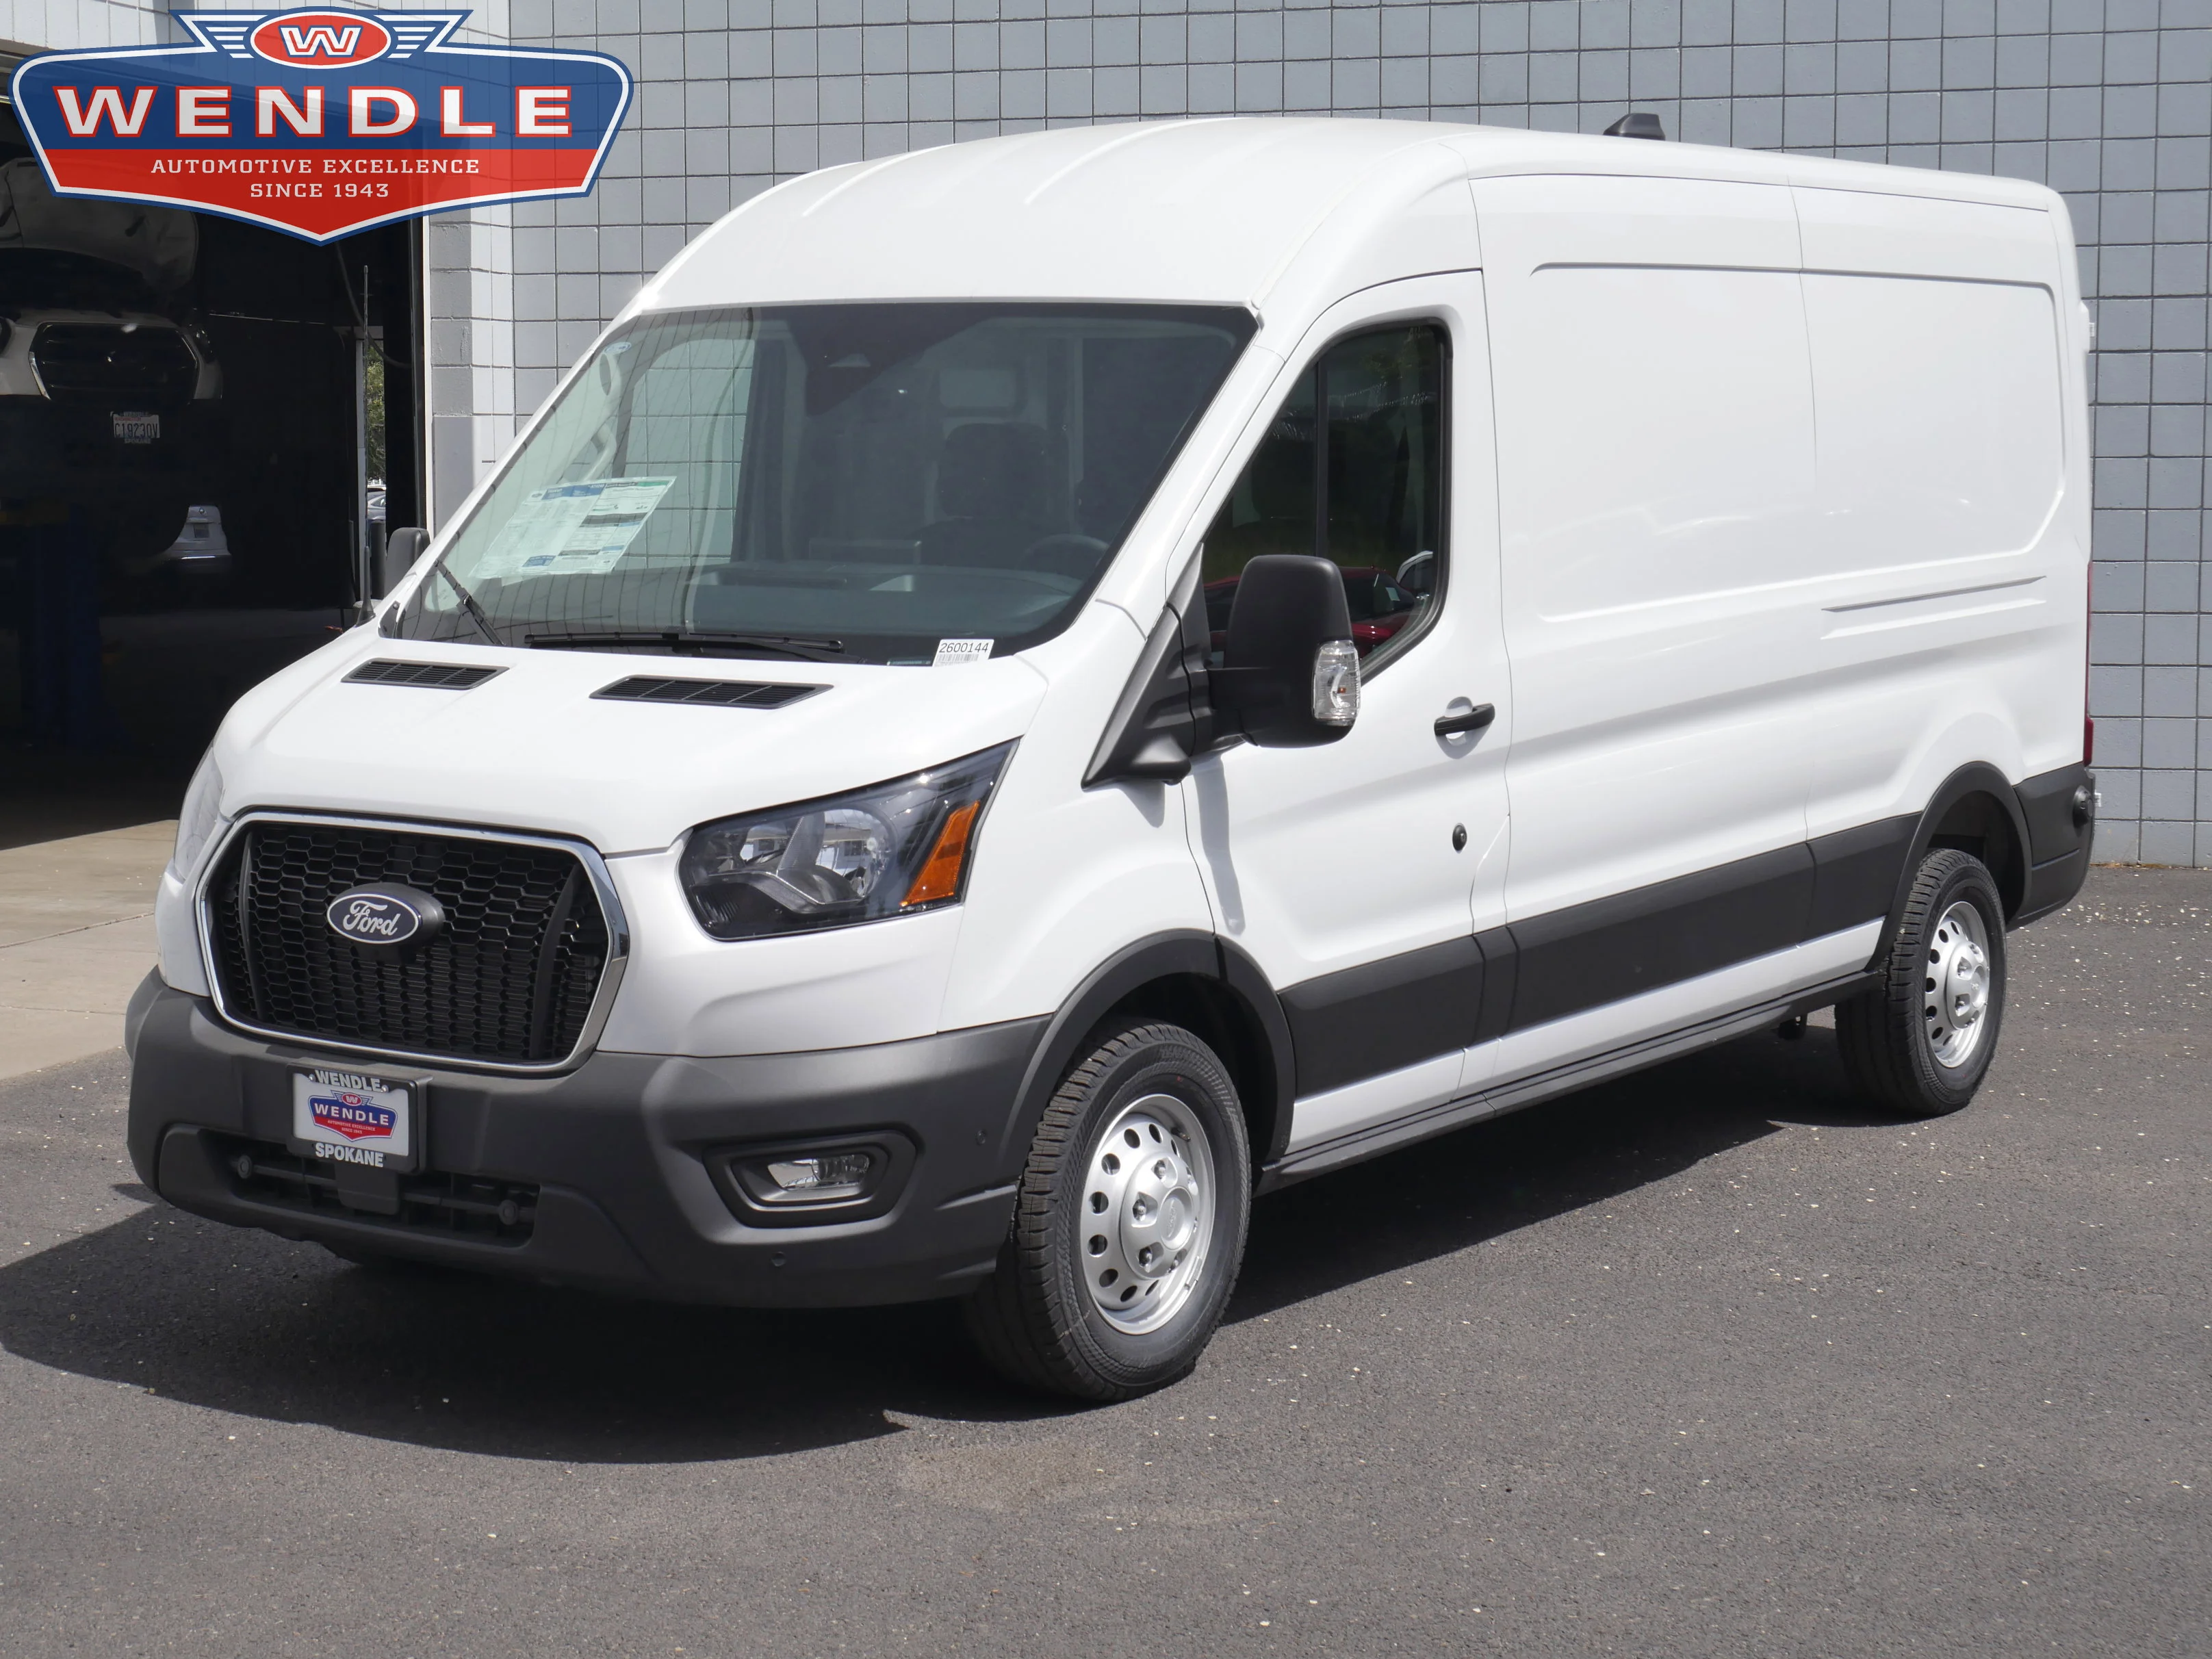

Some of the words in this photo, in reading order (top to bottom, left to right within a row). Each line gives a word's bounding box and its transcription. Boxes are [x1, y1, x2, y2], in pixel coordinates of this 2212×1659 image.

[939, 643, 990, 653] 2600144
[343, 900, 401, 936] Ford
[315, 1069, 381, 1092] WENDLE
[314, 1103, 389, 1126] WENDLE
[315, 1142, 384, 1168] SPOKANE
